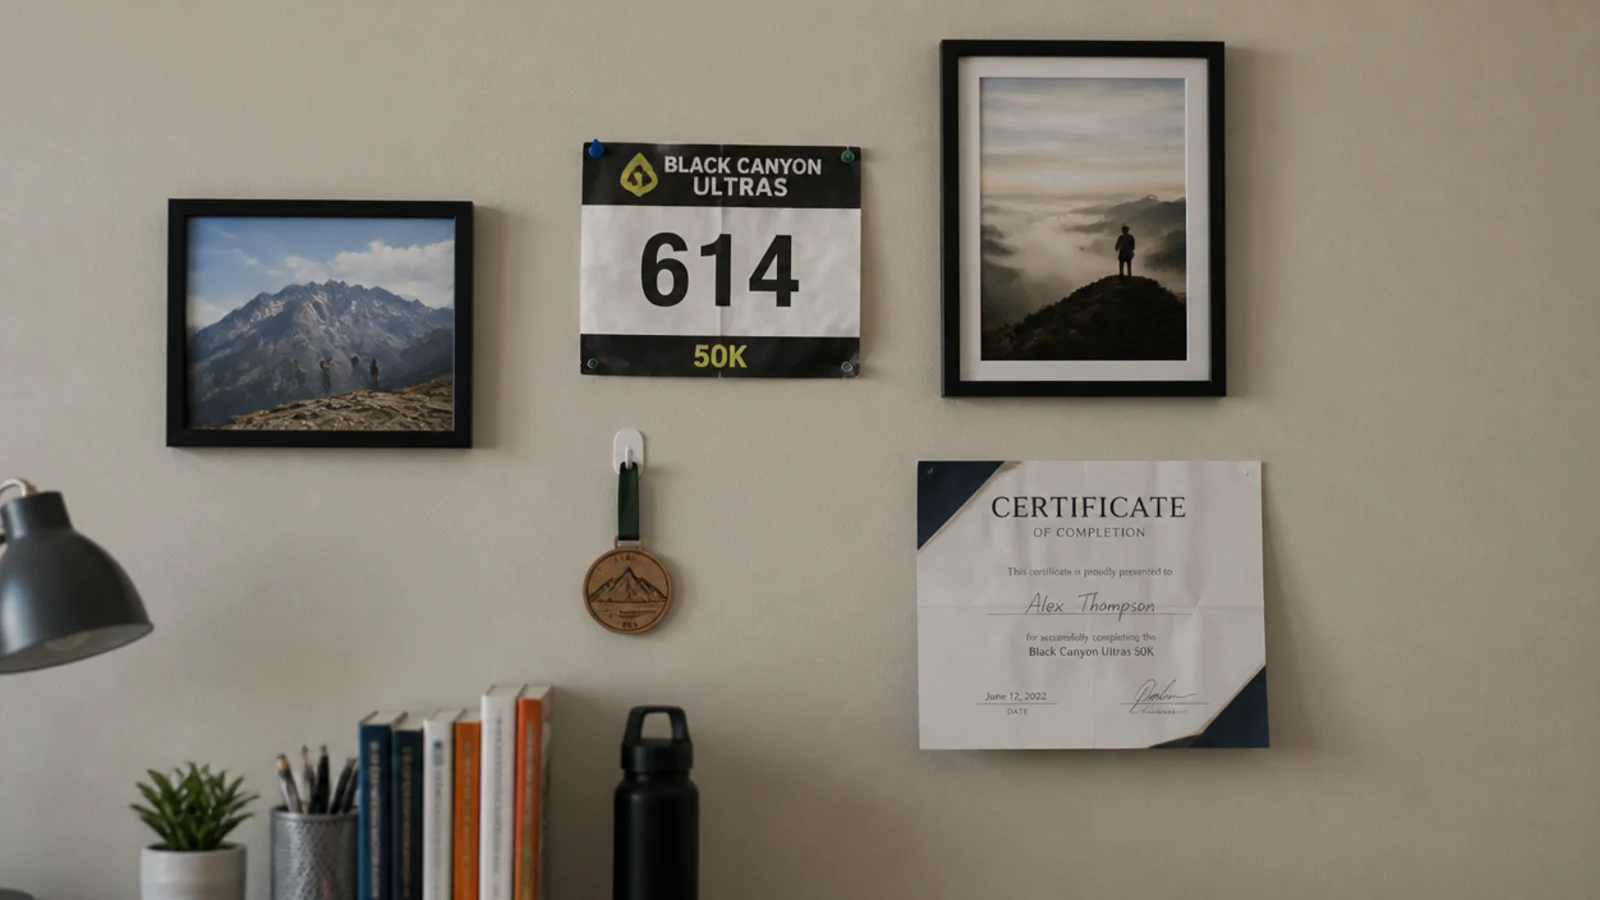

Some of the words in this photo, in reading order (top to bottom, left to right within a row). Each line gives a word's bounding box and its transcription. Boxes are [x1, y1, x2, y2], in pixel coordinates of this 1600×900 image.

[664, 156, 731, 174] BLACK
[737, 157, 822, 175] CANYON
[693, 177, 788, 197] ULTRAS
[640, 231, 800, 308] 614
[693, 344, 748, 368] 50K
[991, 496, 1187, 519] CERTIFICATE
[1033, 527, 1051, 538] OF
[1056, 527, 1146, 538] COMPLETION
[1007, 567, 1027, 577] This
[1074, 567, 1082, 576] is
[1083, 567, 1117, 579] proudly
[1163, 568, 1173, 576] to
[1025, 592, 1064, 613] Alex
[1078, 591, 1155, 621] Thompson
[1092, 632, 1140, 644] completing
[1029, 646, 1057, 657] Black
[1059, 646, 1099, 659] Canyon
[1101, 646, 1132, 657] Ultras
[985, 692, 1007, 702] June
[1009, 692, 1022, 702] 12,
[1024, 692, 1048, 701] 2022
